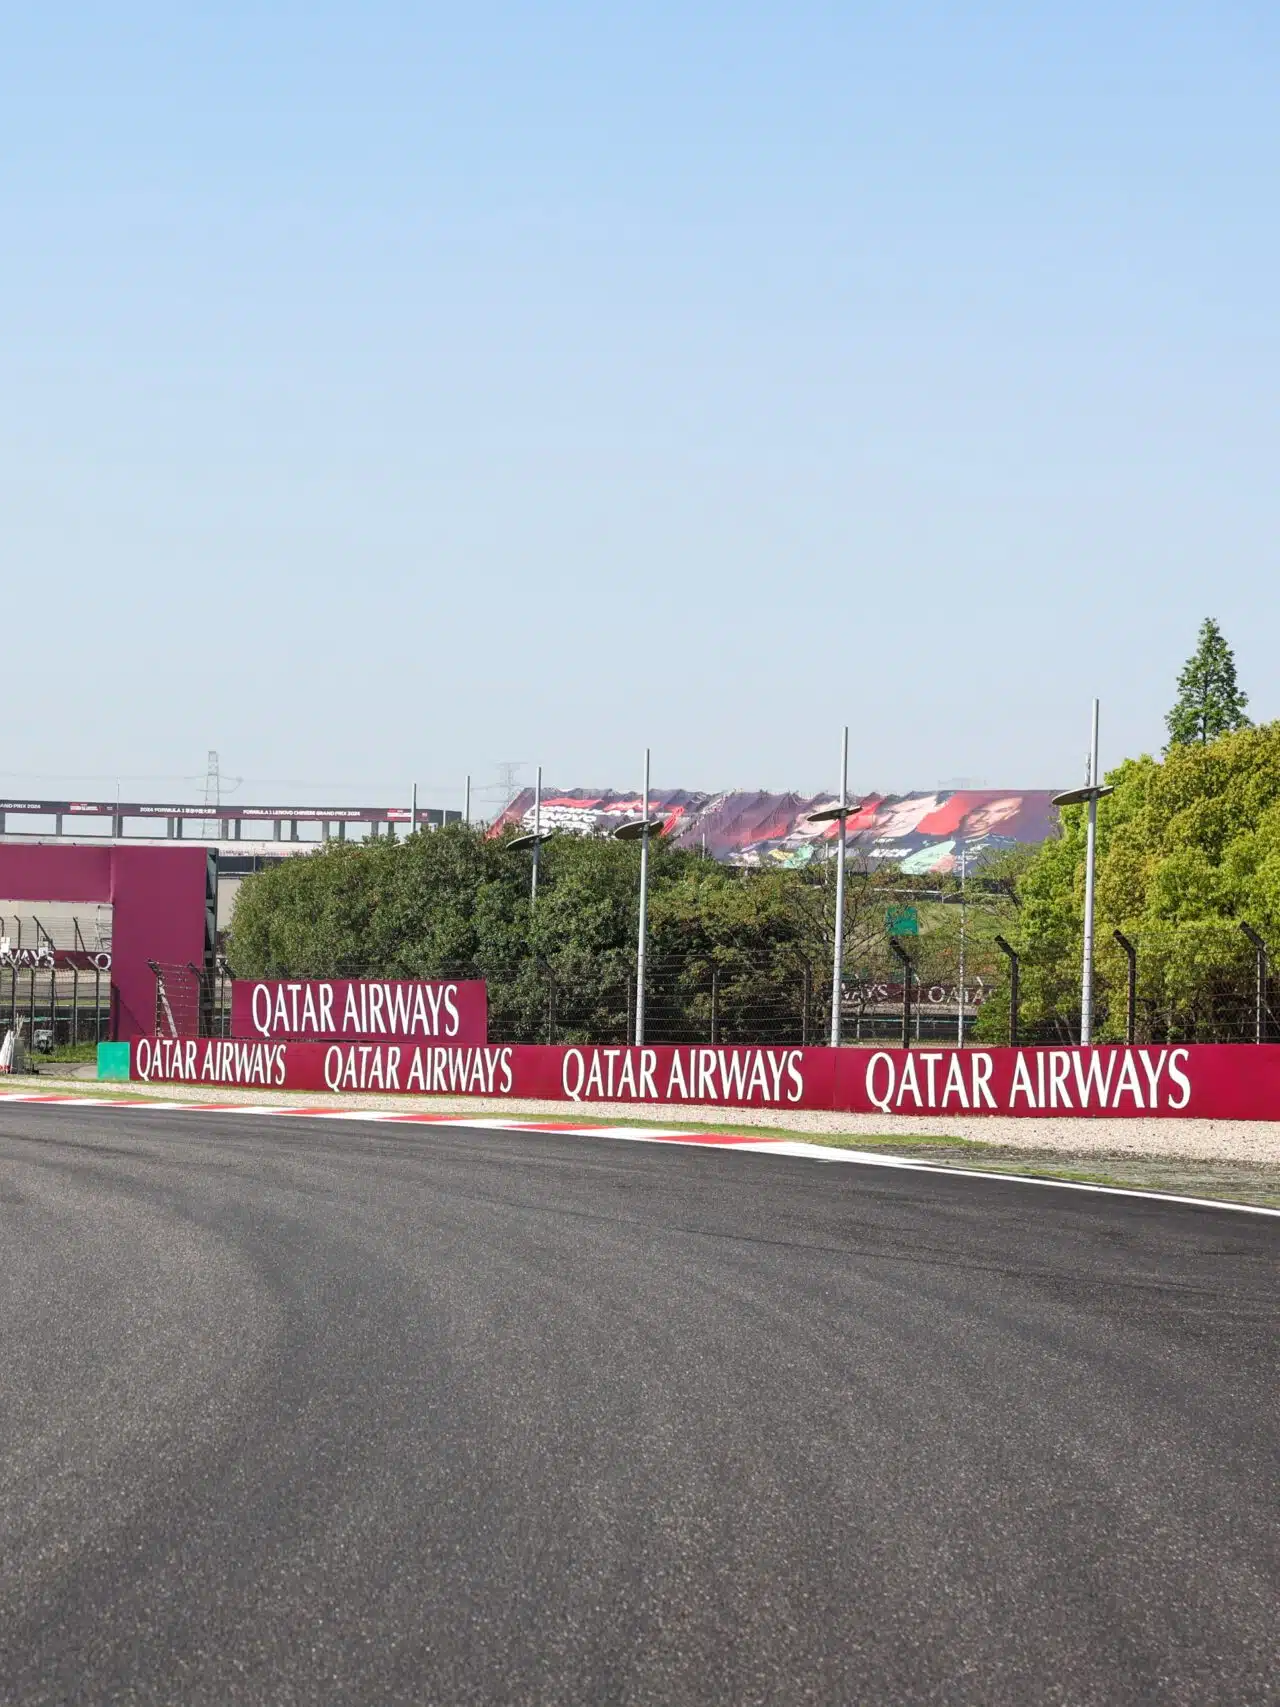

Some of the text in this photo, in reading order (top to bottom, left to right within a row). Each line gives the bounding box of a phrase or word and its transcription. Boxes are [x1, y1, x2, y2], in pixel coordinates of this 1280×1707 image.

[252, 983, 460, 1038] QATAR AIRWAYS
[136, 1038, 287, 1085] QATAR AIRWAYS
[324, 1046, 513, 1093] QATAR AIRWAYS
[562, 1048, 803, 1102] QATAR AIRWAYS
[865, 1048, 1191, 1114] QATAR AIRWAYS
